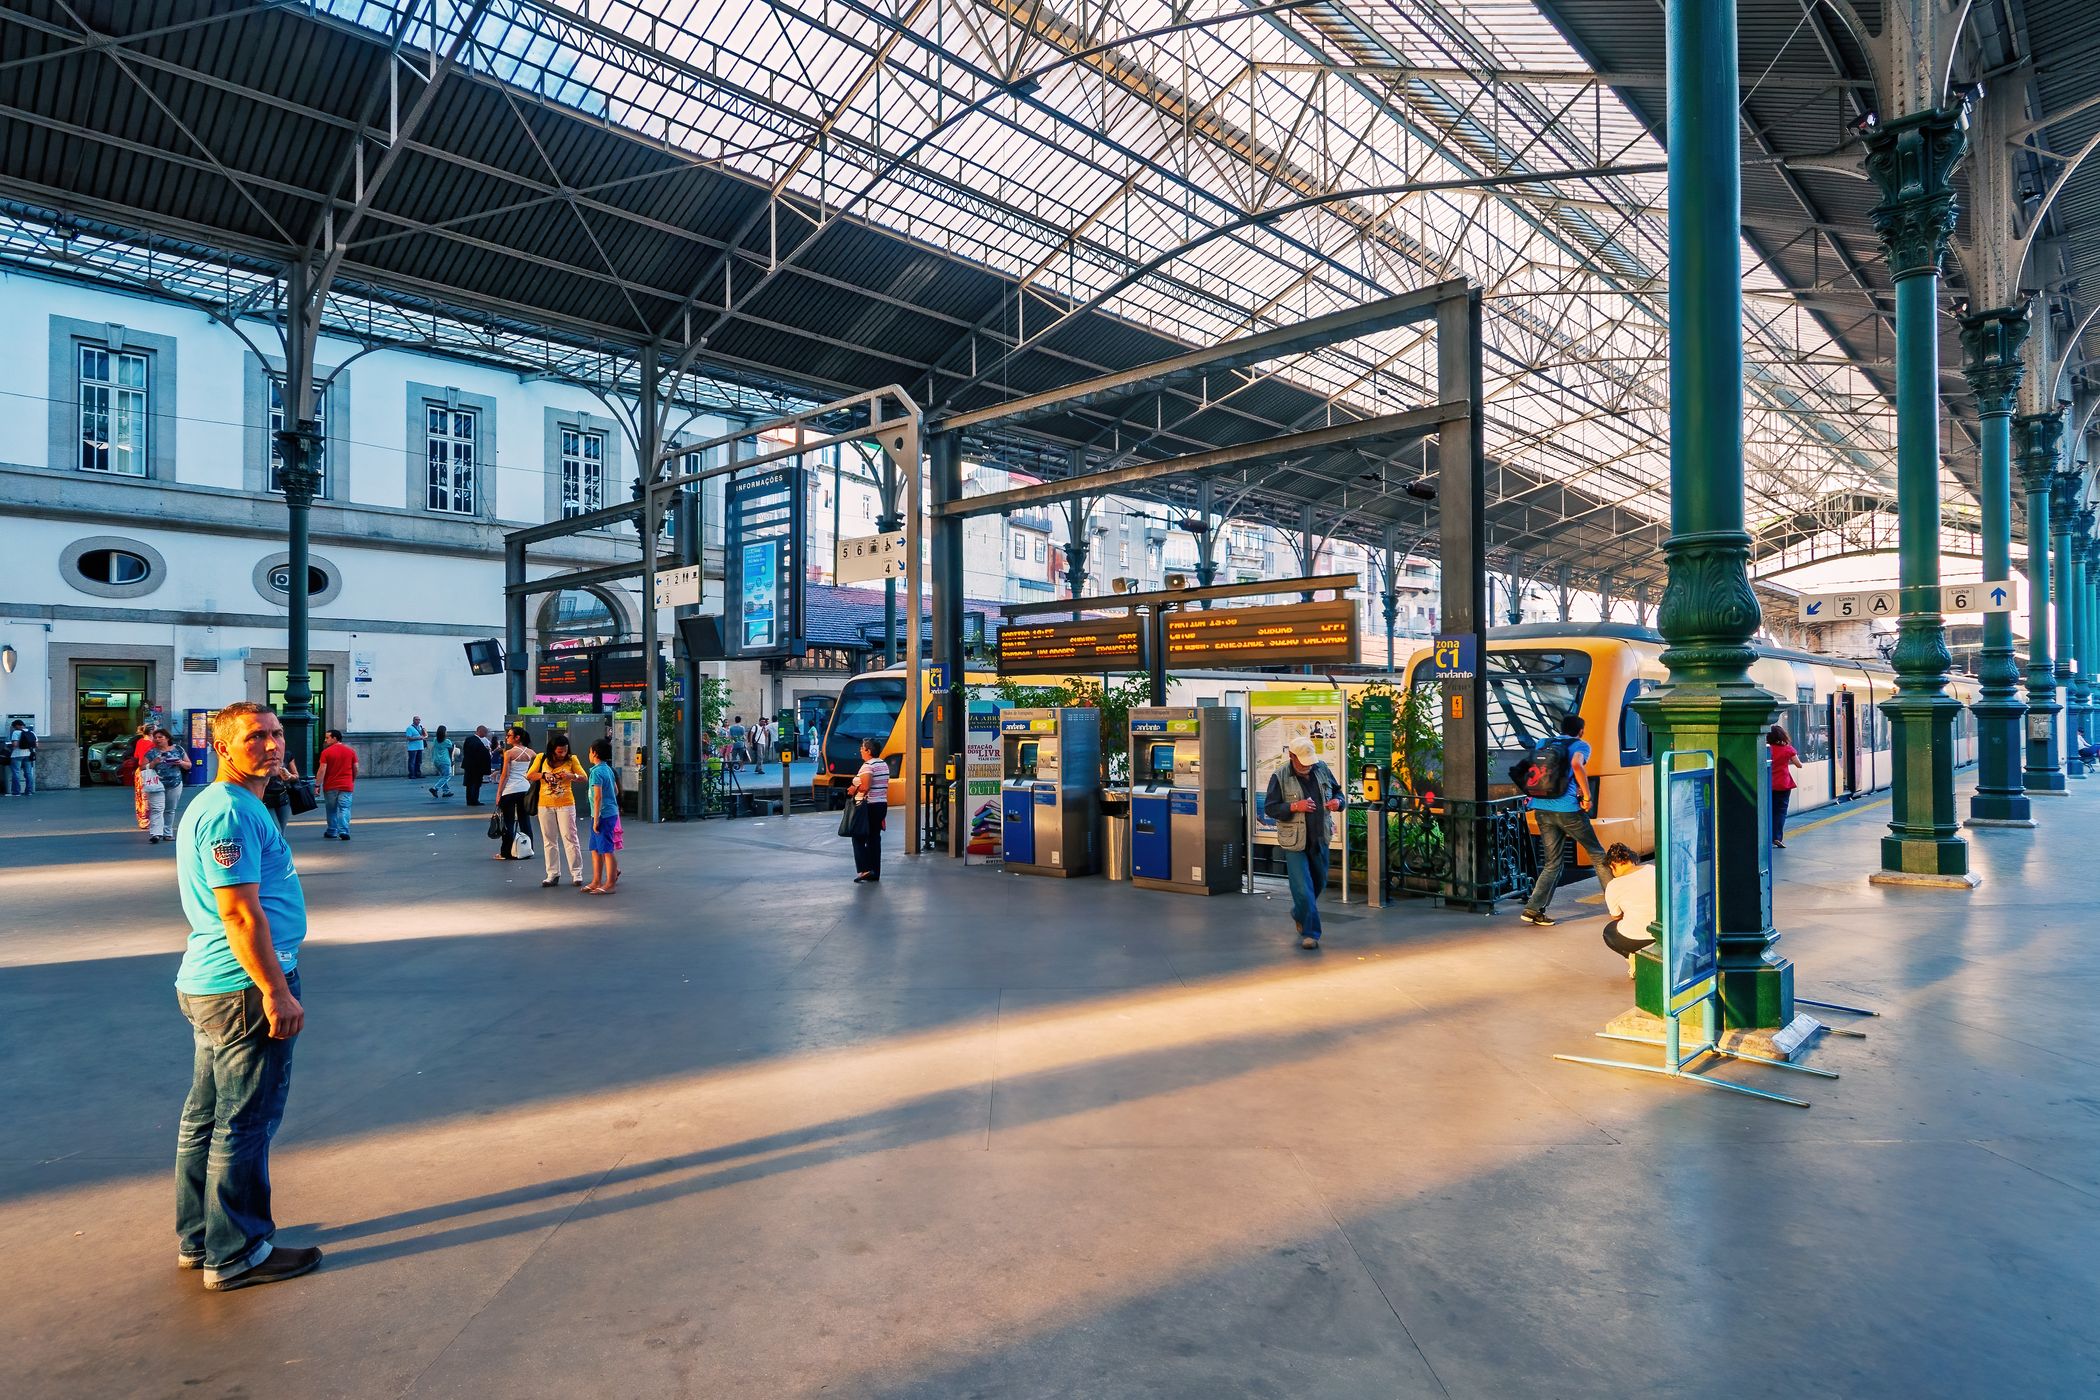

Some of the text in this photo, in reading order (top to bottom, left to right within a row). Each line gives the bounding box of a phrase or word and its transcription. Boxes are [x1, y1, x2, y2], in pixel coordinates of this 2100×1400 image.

[735, 474, 783, 492] INFORMAÇÕES
[843, 545, 863, 558] 5 6
[885, 564, 891, 574] 4
[665, 595, 670, 604] 3
[1842, 597, 1888, 615] 5 A
[1955, 594, 1967, 608] 6
[1436, 640, 1460, 648] zona
[1435, 648, 1459, 669] C1
[931, 673, 942, 687] C1
[1435, 669, 1473, 679] andante
